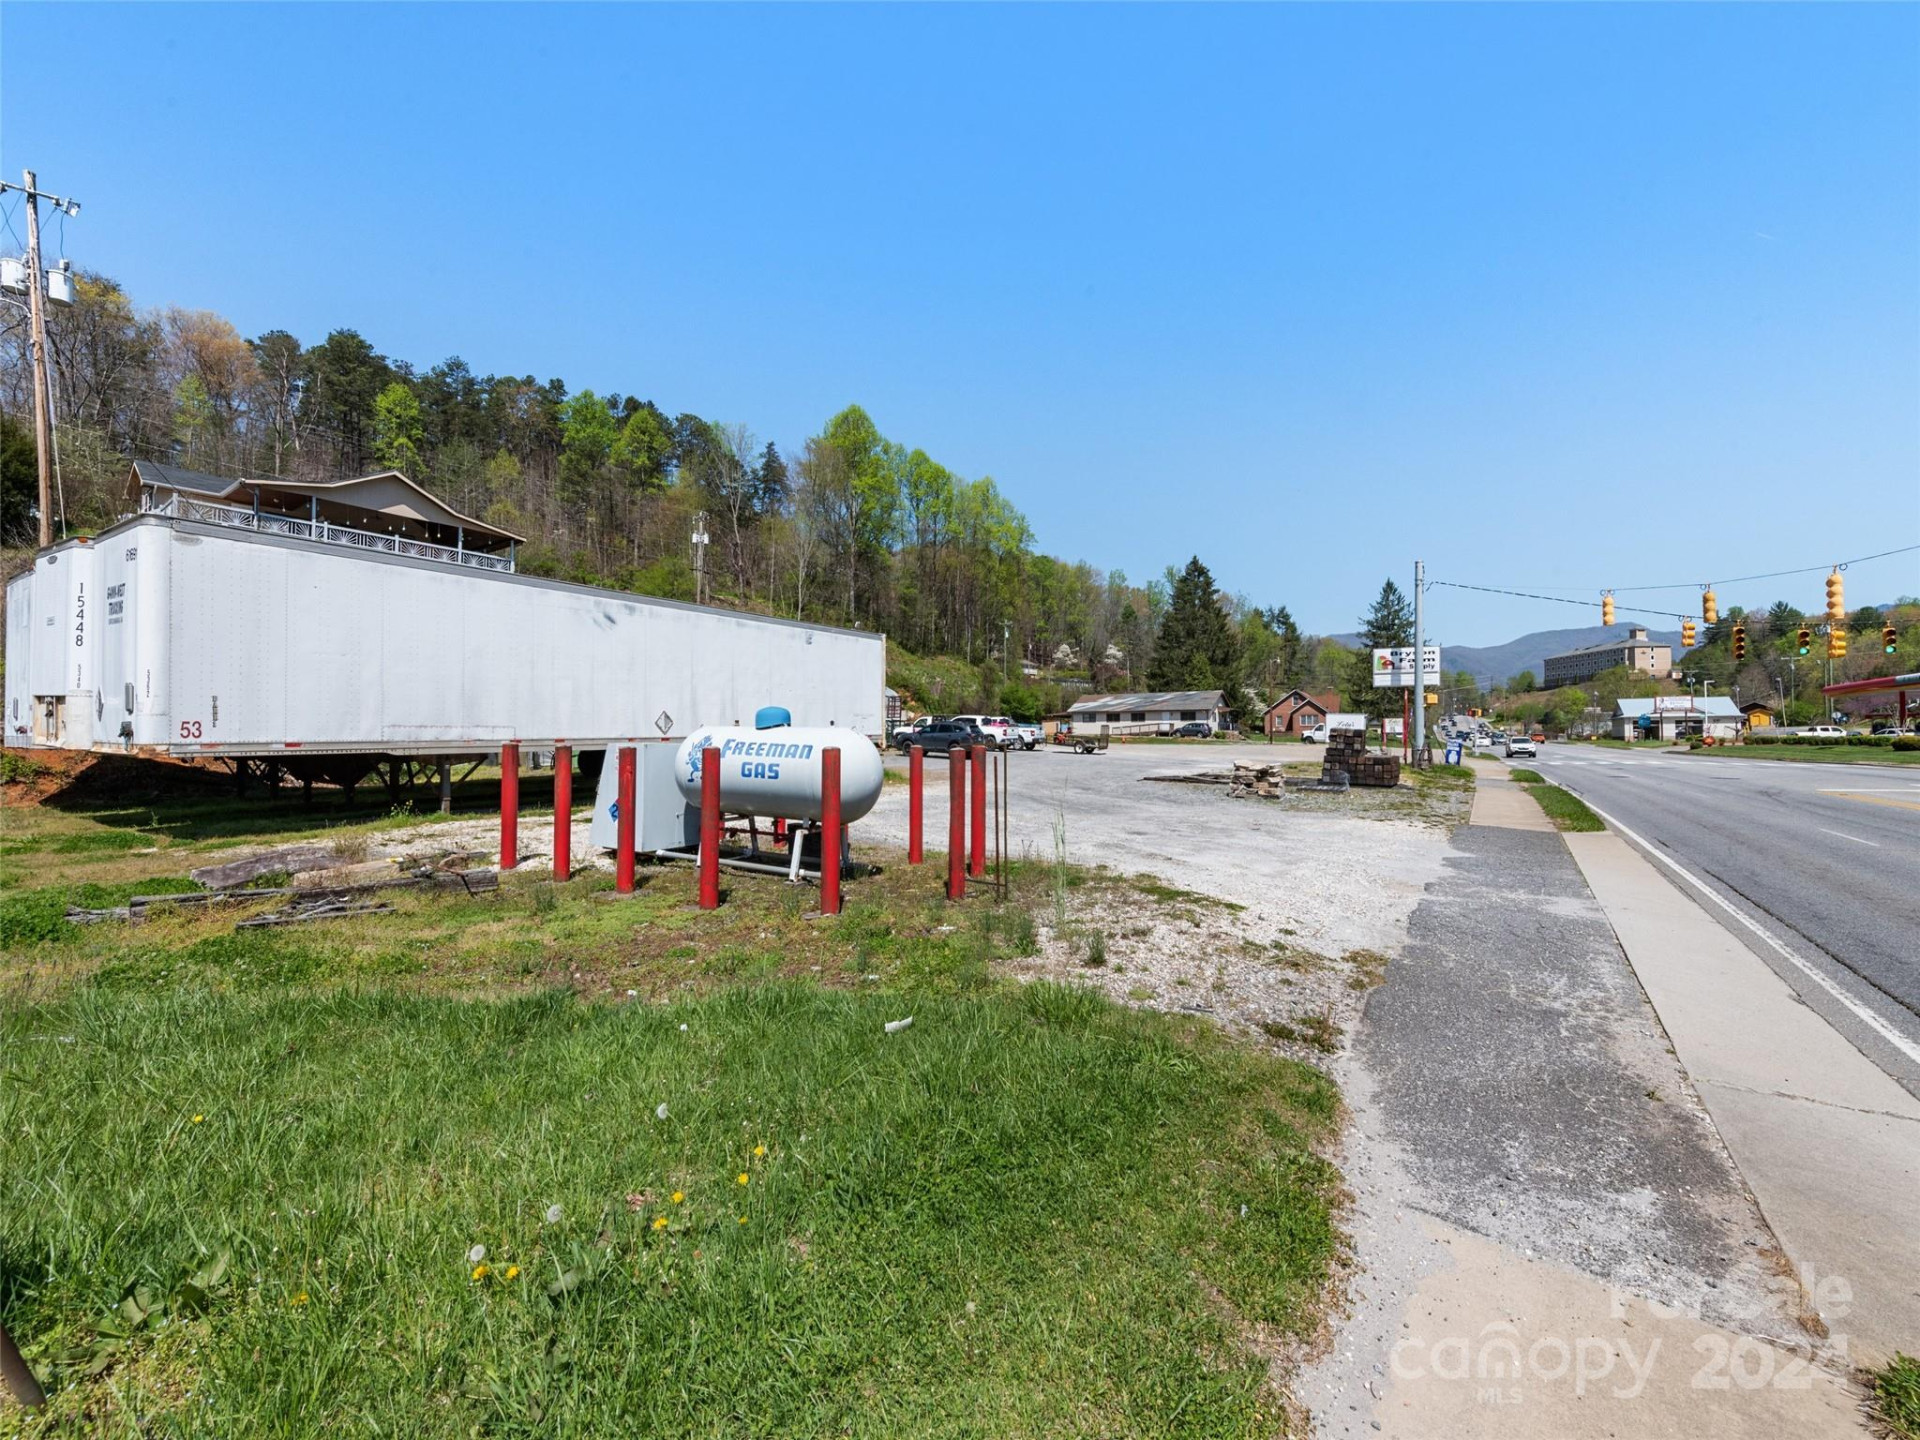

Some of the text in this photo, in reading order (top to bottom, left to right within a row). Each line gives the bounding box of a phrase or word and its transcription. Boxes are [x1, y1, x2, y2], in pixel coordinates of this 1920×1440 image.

[75, 582, 86, 647] 15448
[180, 721, 202, 739] 53
[741, 761, 780, 780] GAS
